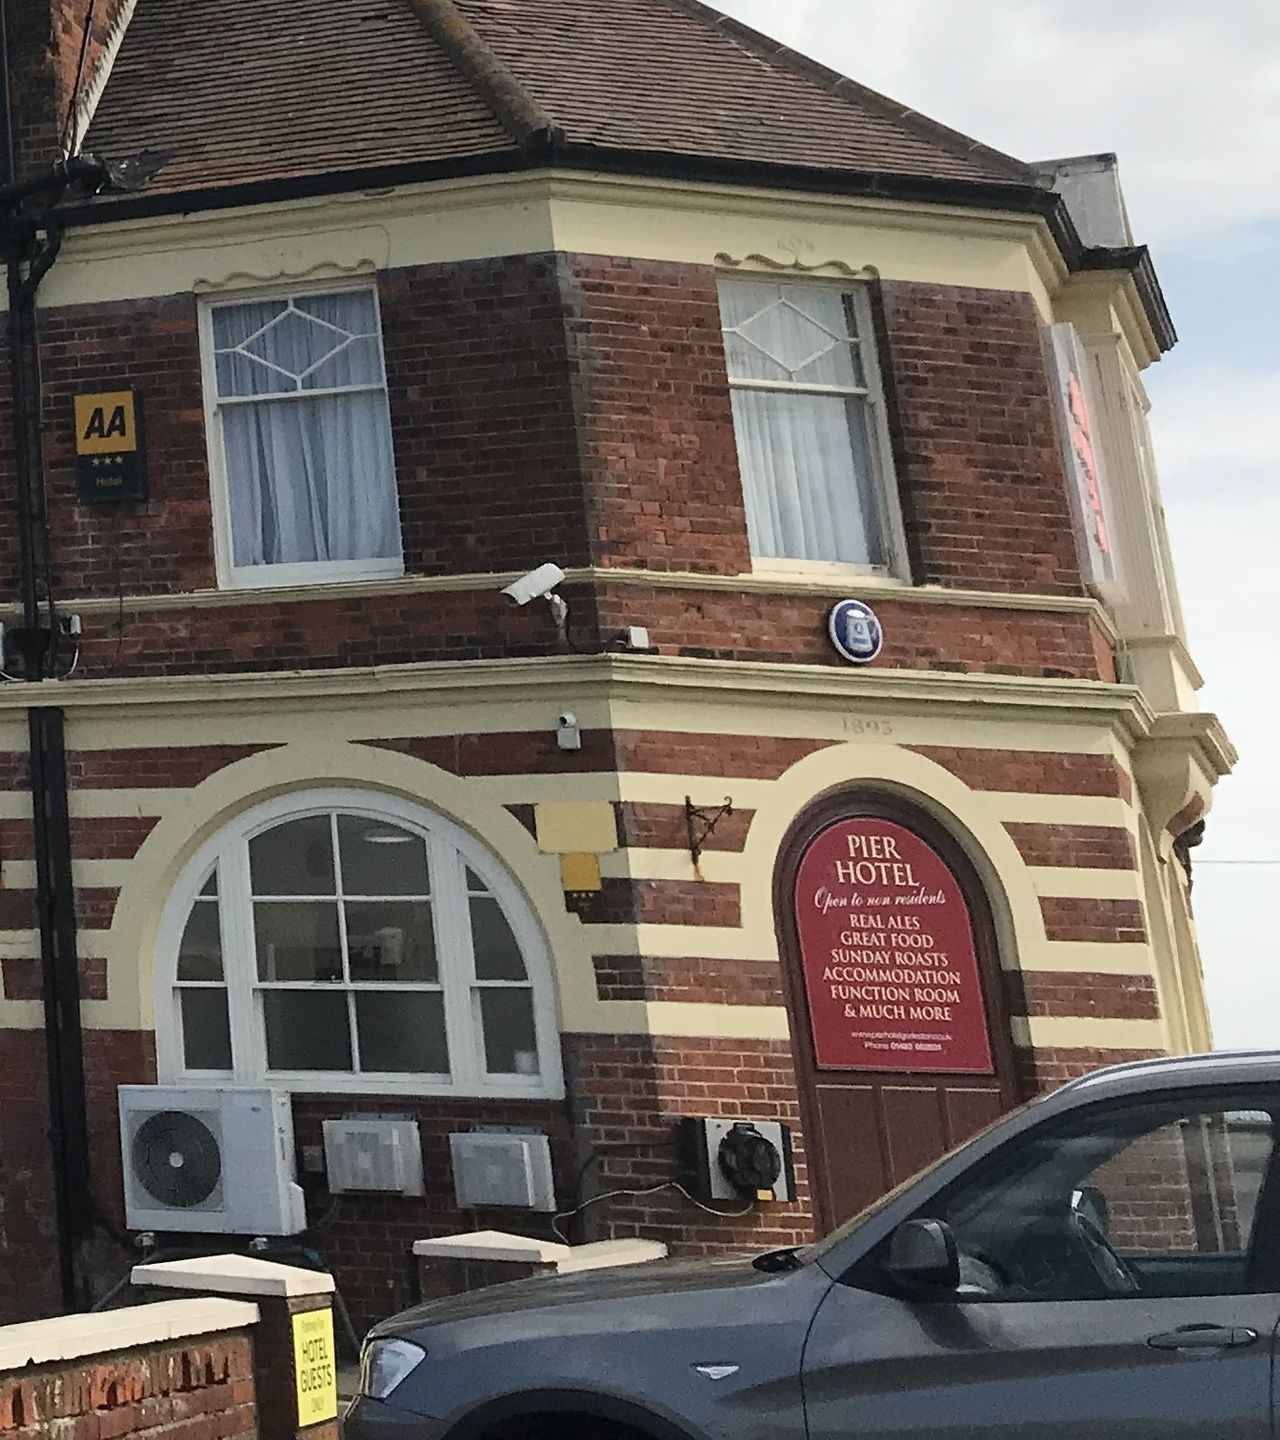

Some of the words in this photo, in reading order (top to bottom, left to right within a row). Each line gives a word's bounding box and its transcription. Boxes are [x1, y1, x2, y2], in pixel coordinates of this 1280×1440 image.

[84, 405, 126, 440] AA
[847, 835, 901, 860] PIER
[836, 861, 920, 887] HOTEL
[814, 886, 847, 914] Open
[851, 892, 863, 907] to
[866, 895, 891, 907] non
[895, 887, 946, 906] residents
[850, 913, 885, 929] REAL
[888, 914, 920, 931] ALES
[840, 930, 886, 947] GREAT
[891, 932, 934, 948] FOOD
[831, 949, 890, 966] SUNDAY
[896, 951, 948, 967] ROASTS
[822, 966, 961, 985] ACCOMMODATION
[831, 985, 910, 1002] FUNCTION
[915, 988, 960, 1004] ROOM
[844, 1004, 857, 1018] &
[859, 1004, 905, 1020] MUCH
[910, 1006, 953, 1021] MORE
[302, 1337, 328, 1363] HOTEL
[300, 1364, 333, 1392] GUESTS
